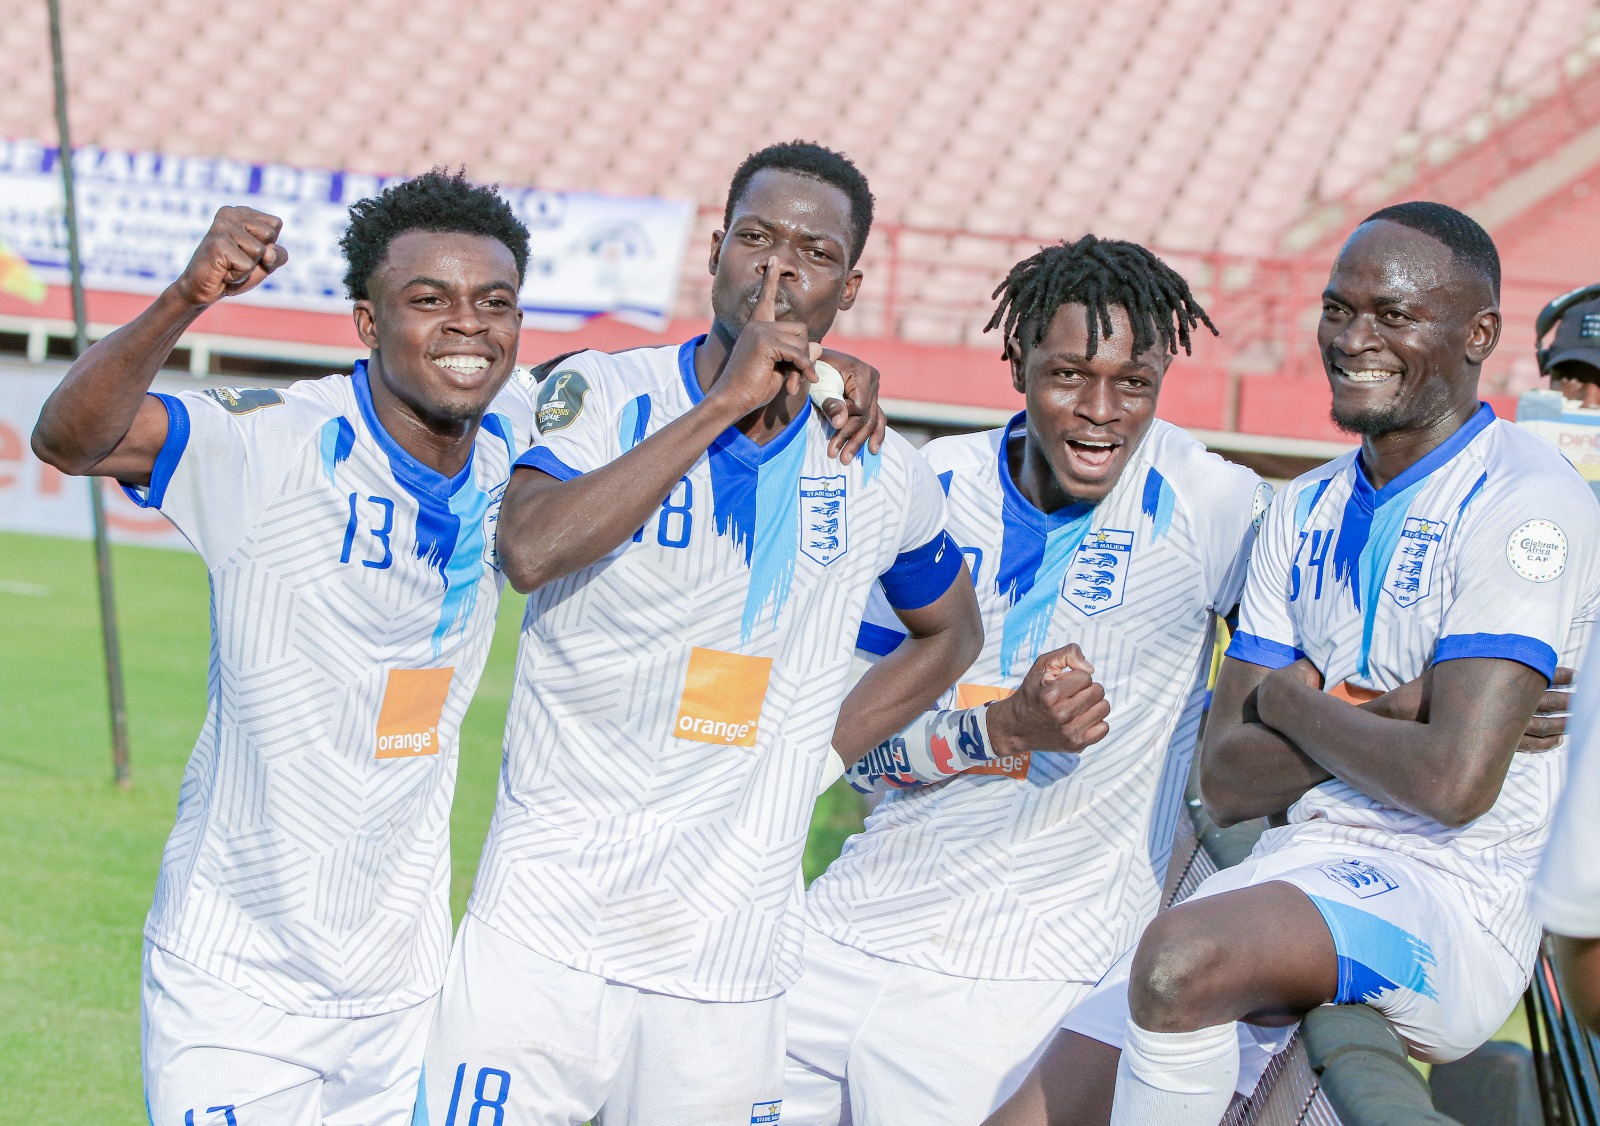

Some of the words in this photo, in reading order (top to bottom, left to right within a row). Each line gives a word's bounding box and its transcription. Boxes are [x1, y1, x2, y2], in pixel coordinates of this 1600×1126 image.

[340, 492, 394, 570] 13
[633, 475, 693, 549] 8
[1100, 542, 1125, 551] MALIEN
[1520, 538, 1559, 551] Celebrate
[1526, 545, 1551, 556] Africa
[445, 1062, 512, 1126] 18
